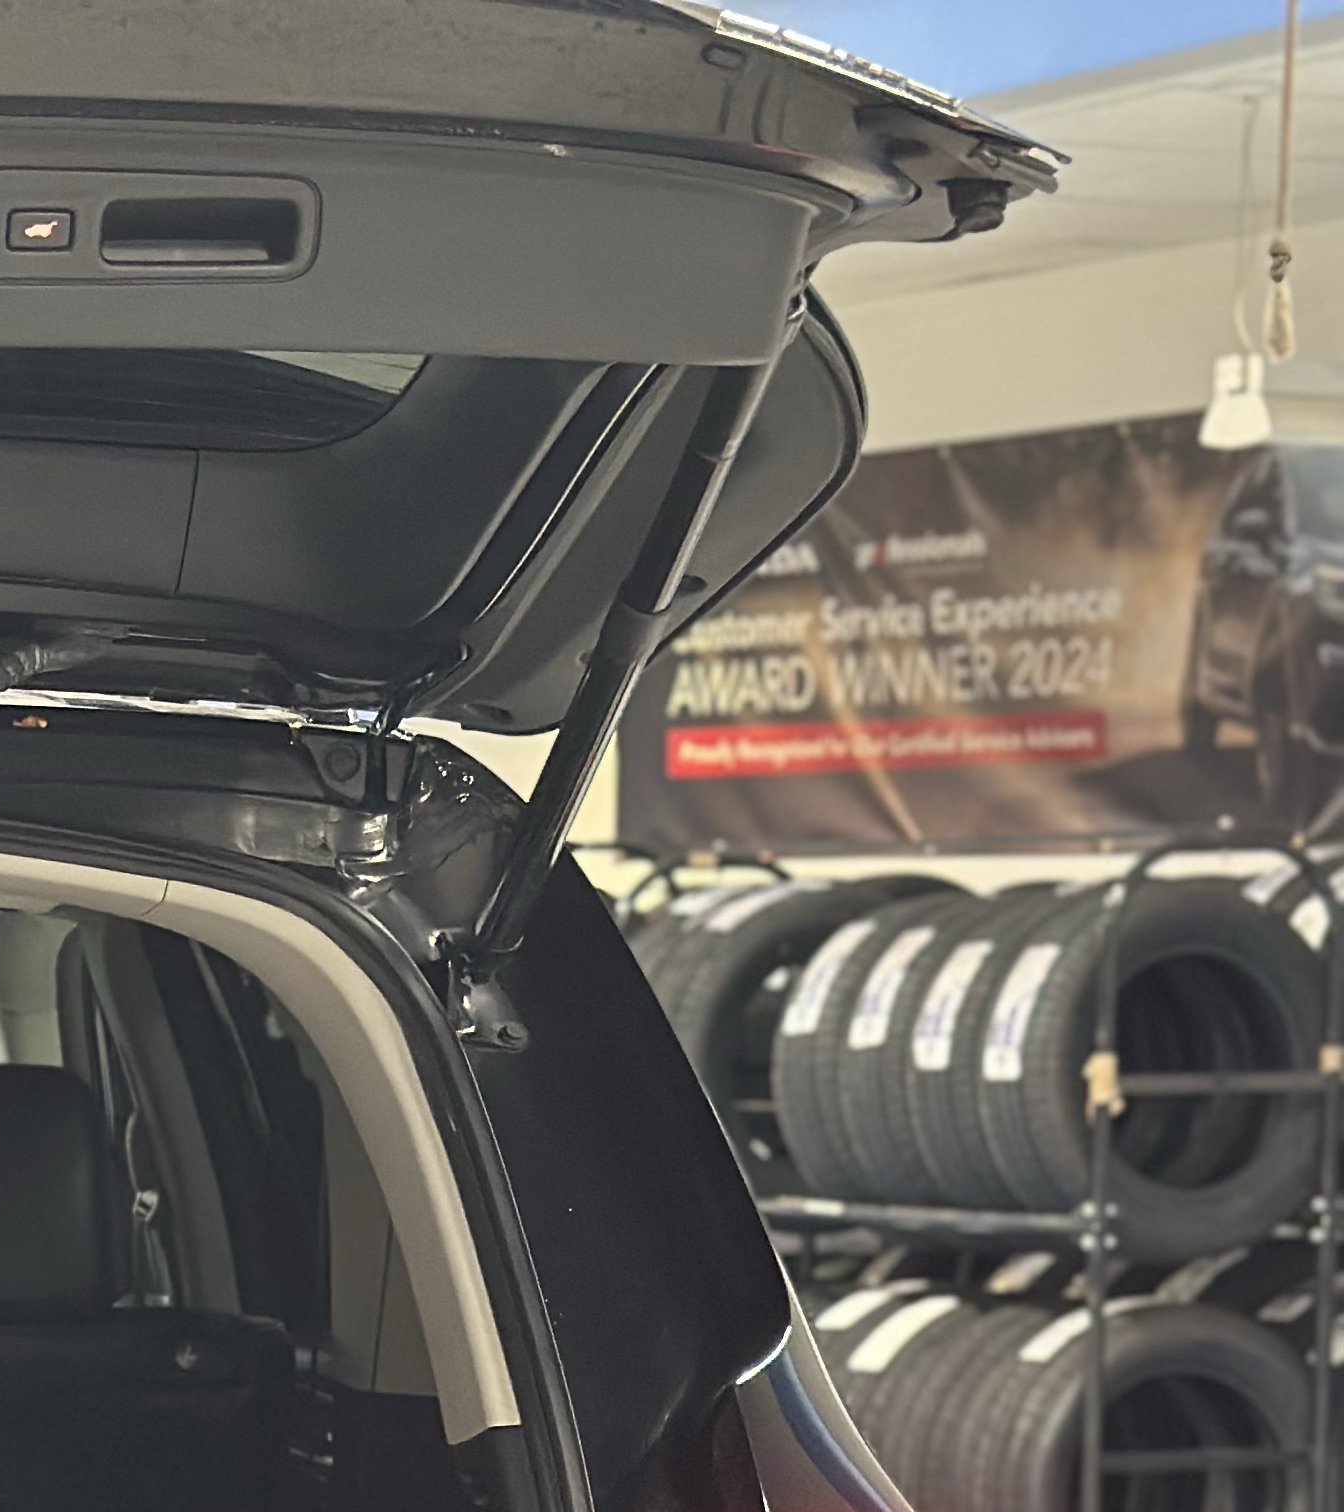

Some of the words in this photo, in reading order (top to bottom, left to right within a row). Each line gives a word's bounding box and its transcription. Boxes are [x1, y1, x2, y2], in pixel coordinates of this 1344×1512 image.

[819, 593, 925, 642] Service
[930, 581, 1121, 642] Experience
[665, 655, 815, 718] AWARD
[828, 643, 1000, 706] WINNER
[1006, 634, 1113, 699] 2024
